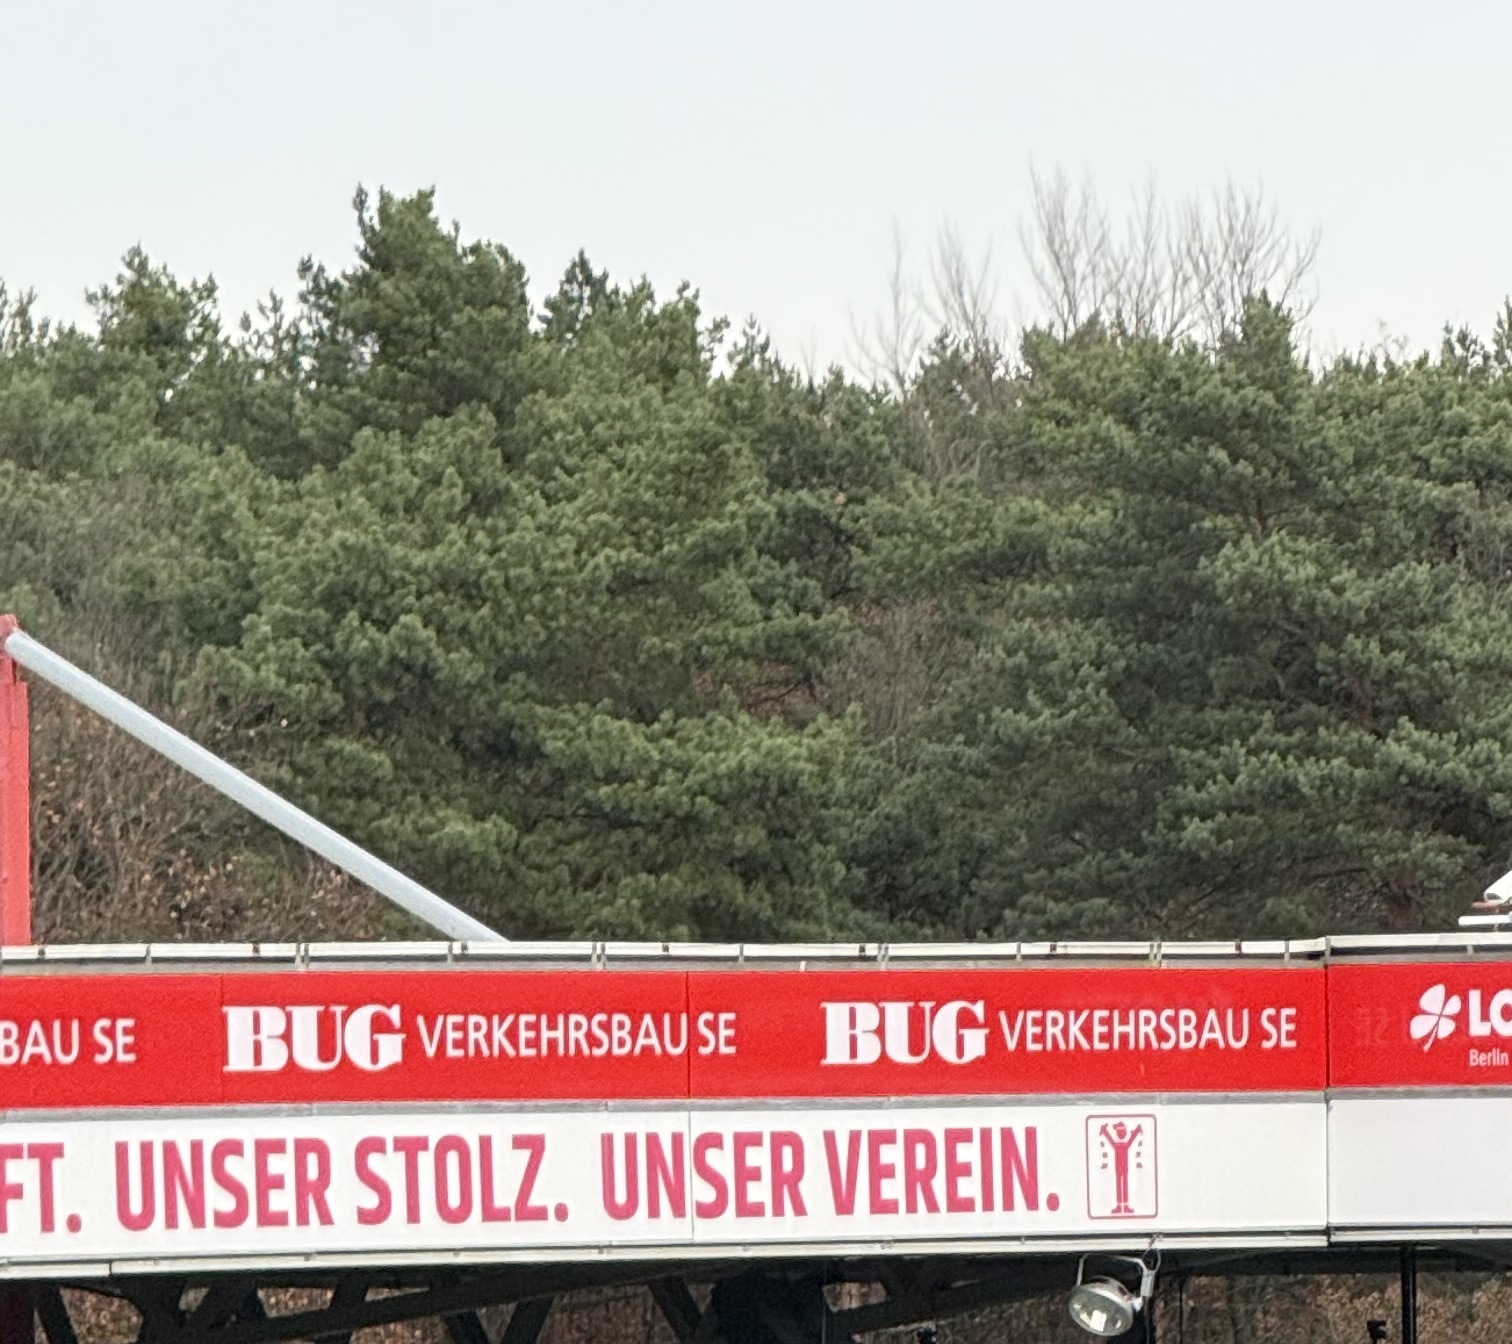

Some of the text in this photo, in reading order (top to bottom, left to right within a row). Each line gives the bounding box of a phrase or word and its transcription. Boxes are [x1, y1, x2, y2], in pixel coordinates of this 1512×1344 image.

[93, 1018, 137, 1063] SE
[221, 1004, 738, 1072] BUG VERKEHRSBAU SE
[820, 1000, 1297, 1065] BUG VERKEHRSBAU SE
[1469, 1047, 1509, 1067] Berlin
[115, 1137, 335, 1232] UNSER
[354, 1132, 569, 1228] STOLZ.
[601, 1129, 807, 1221] UNSER
[823, 1125, 1061, 1217] VEREIN.
